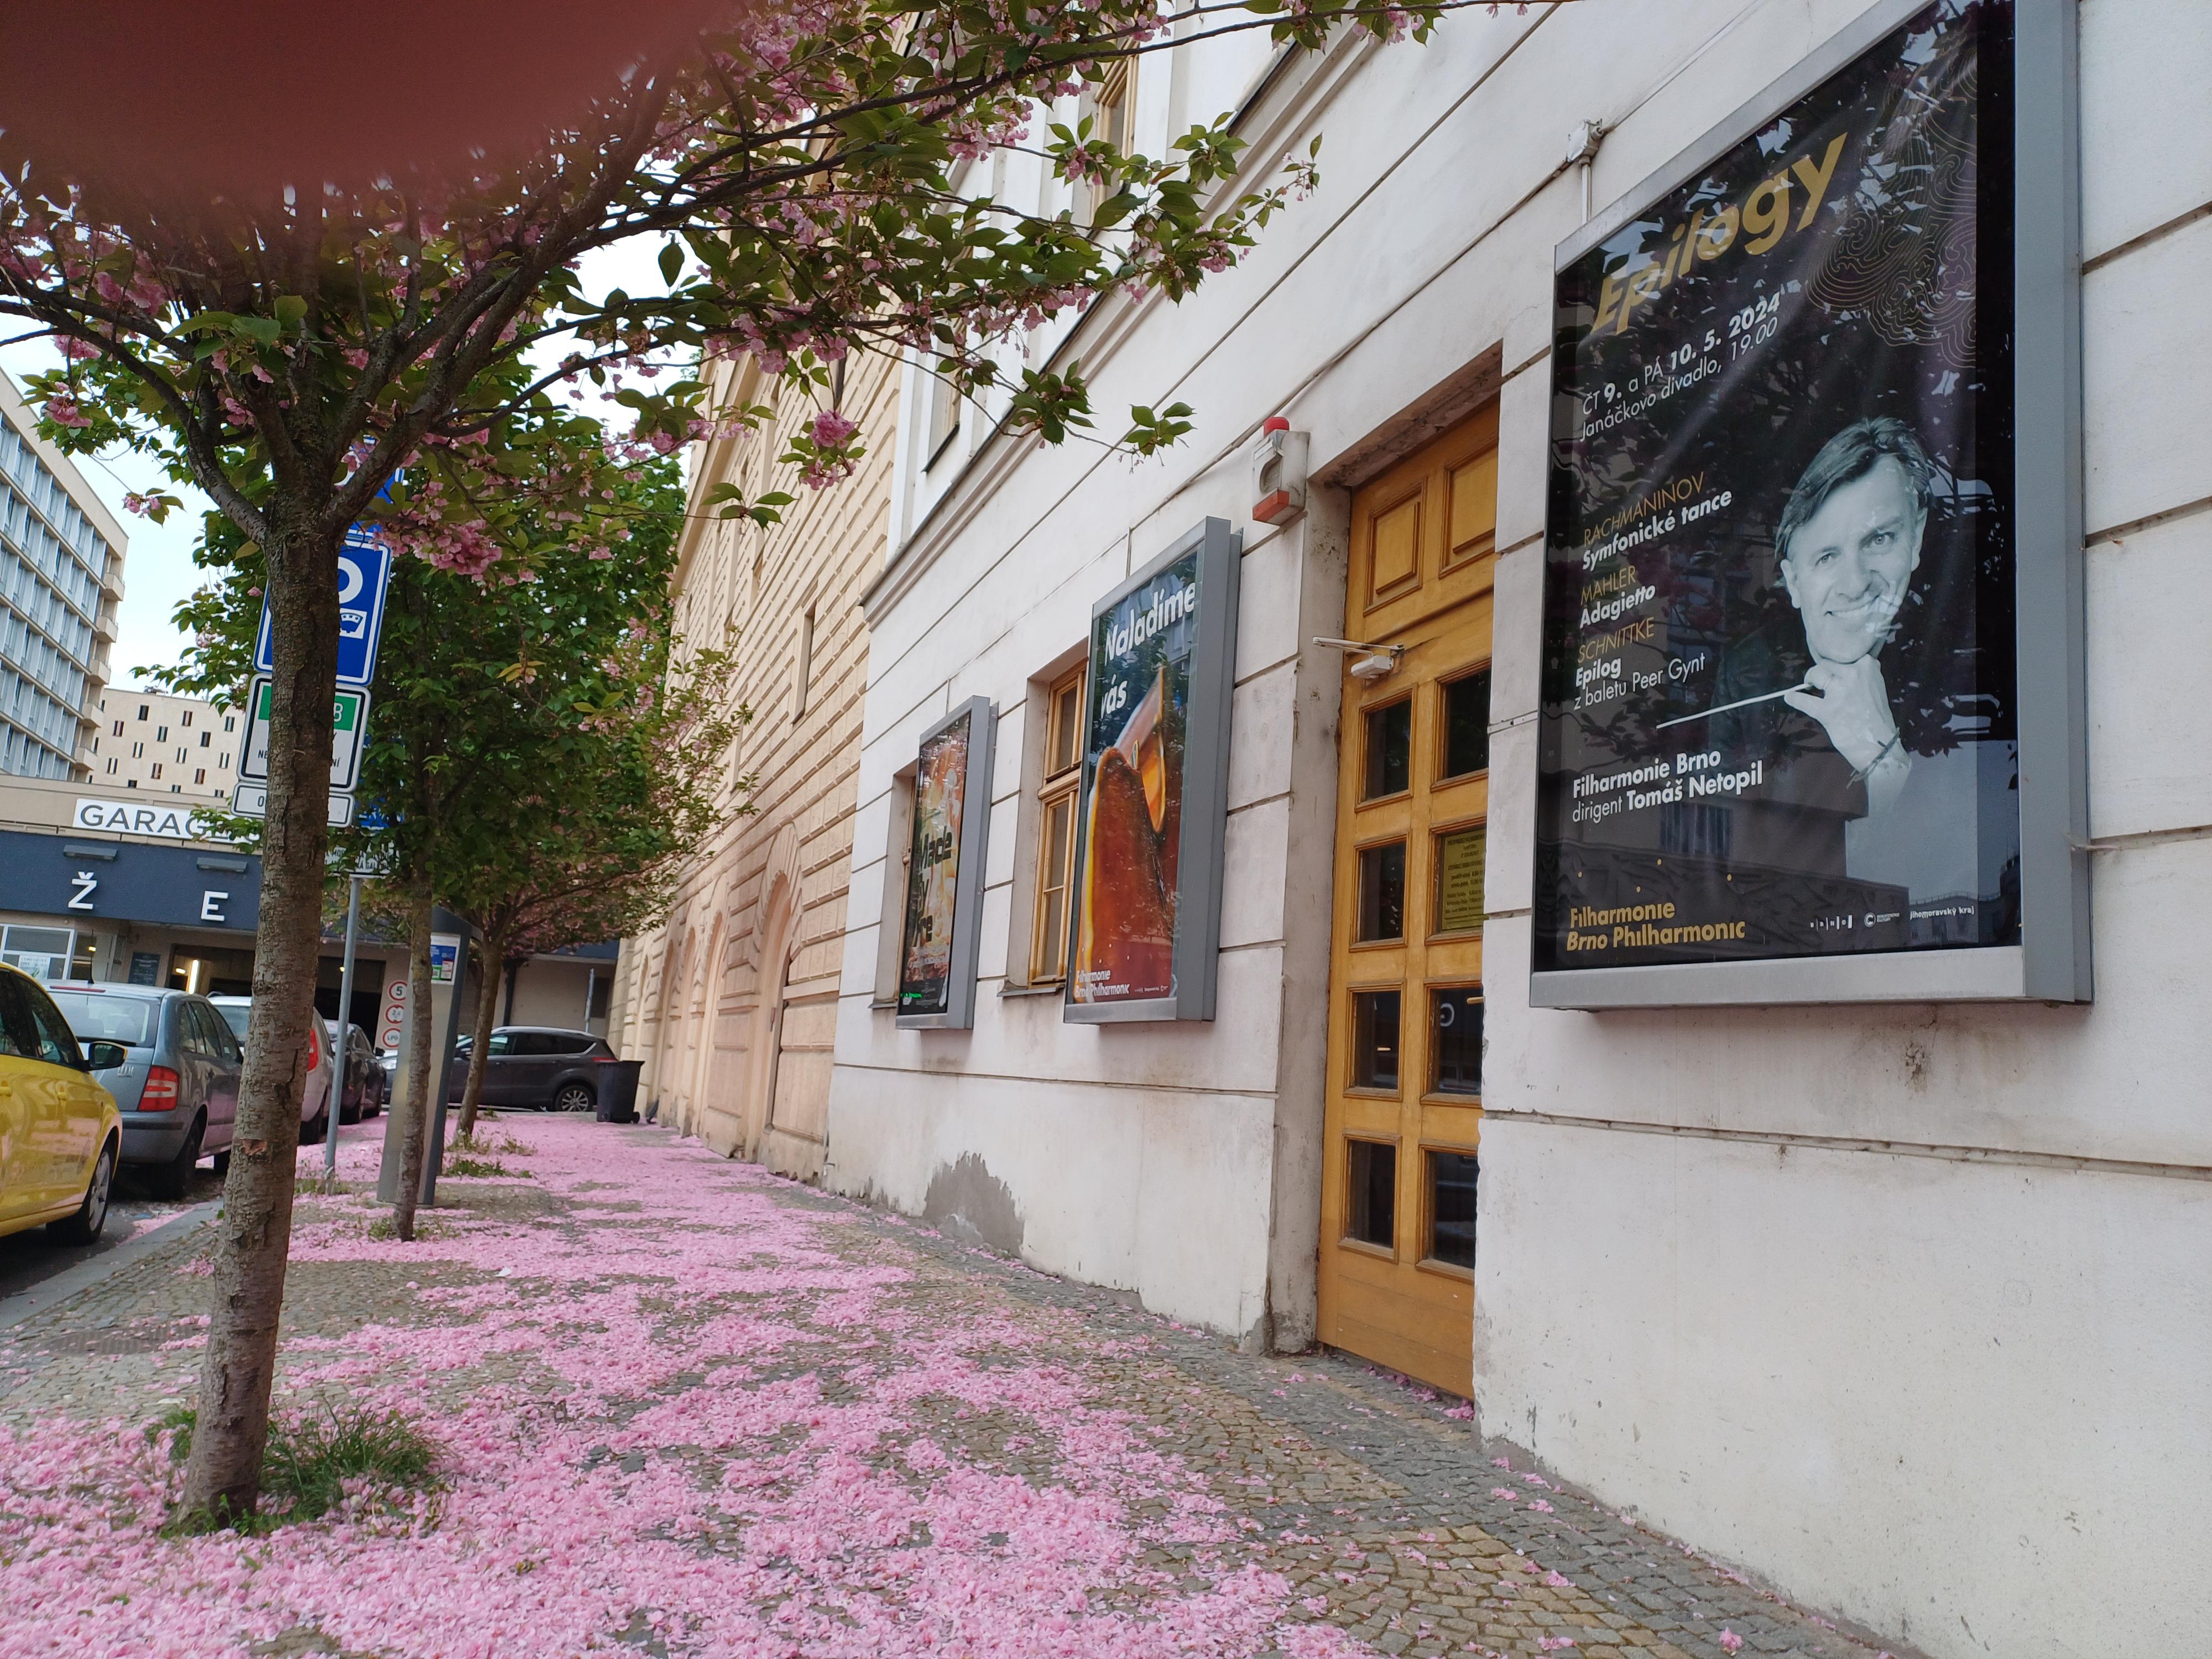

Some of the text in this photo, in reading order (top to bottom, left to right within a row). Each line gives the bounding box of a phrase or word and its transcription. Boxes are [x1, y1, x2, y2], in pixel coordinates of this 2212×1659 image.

[1590, 132, 1848, 335] Epilogy
[1582, 290, 1781, 418] ČT 9. a PÁ 10. 5. 2024
[1580, 316, 1778, 443] Janáčkovo divadlo, 19.00
[1582, 489, 1732, 571] Symfonické tance
[1583, 471, 1705, 546] RACHMANINOV
[1579, 585, 1656, 629] Adagietto
[1580, 565, 1637, 606] MAHLER
[1104, 582, 1196, 666] Naladíme
[1578, 616, 1655, 664] SCHNITTKE
[1099, 673, 1128, 721] vás
[1573, 652, 1705, 711] z baletu Peer Gynt
[1575, 656, 1622, 689] Epilog
[1572, 760, 1764, 824] dirigent Tomáš Netopil
[1573, 748, 1721, 798] Filharmonie Brno
[1567, 920, 1746, 951] Brno Philharmonic
[1569, 902, 1676, 930] Filharmonie
[396, 986, 403, 996] 5
